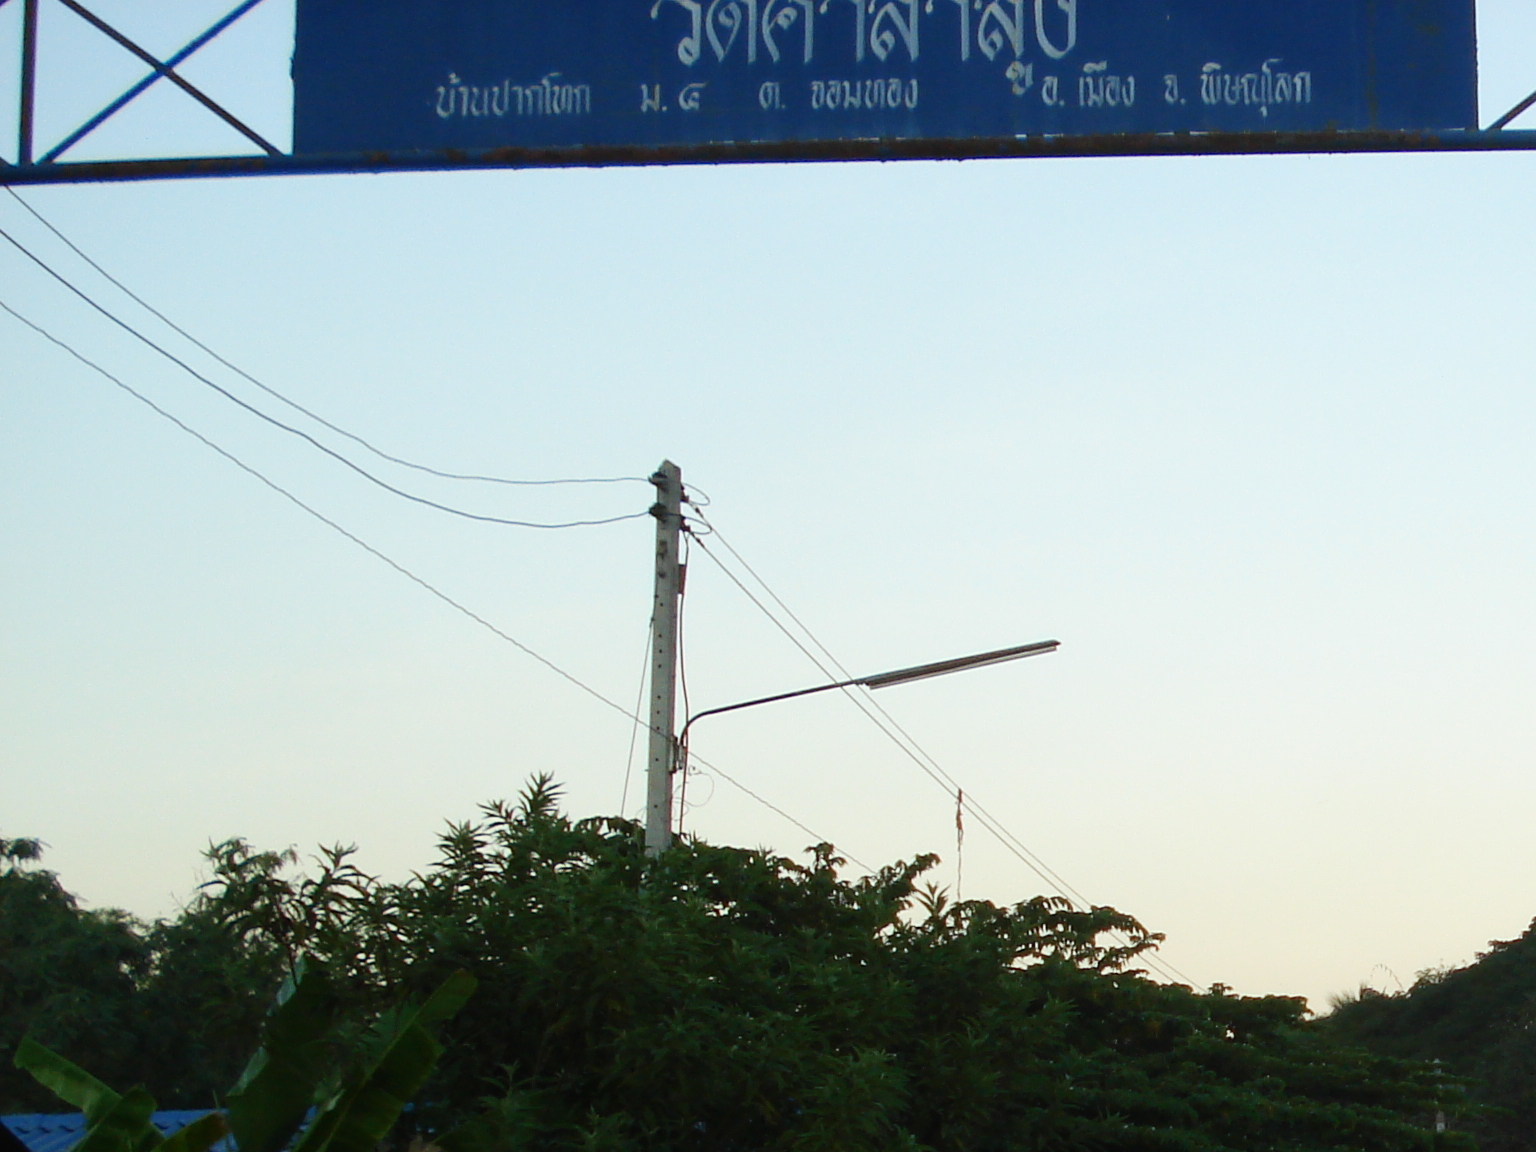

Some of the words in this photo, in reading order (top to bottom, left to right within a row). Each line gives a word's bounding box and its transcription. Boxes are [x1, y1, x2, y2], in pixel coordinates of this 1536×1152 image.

[811, 78, 919, 110] จอมทอง
[1078, 60, 1136, 107] เมือง
[1200, 58, 1312, 117] พิษณุโลก
